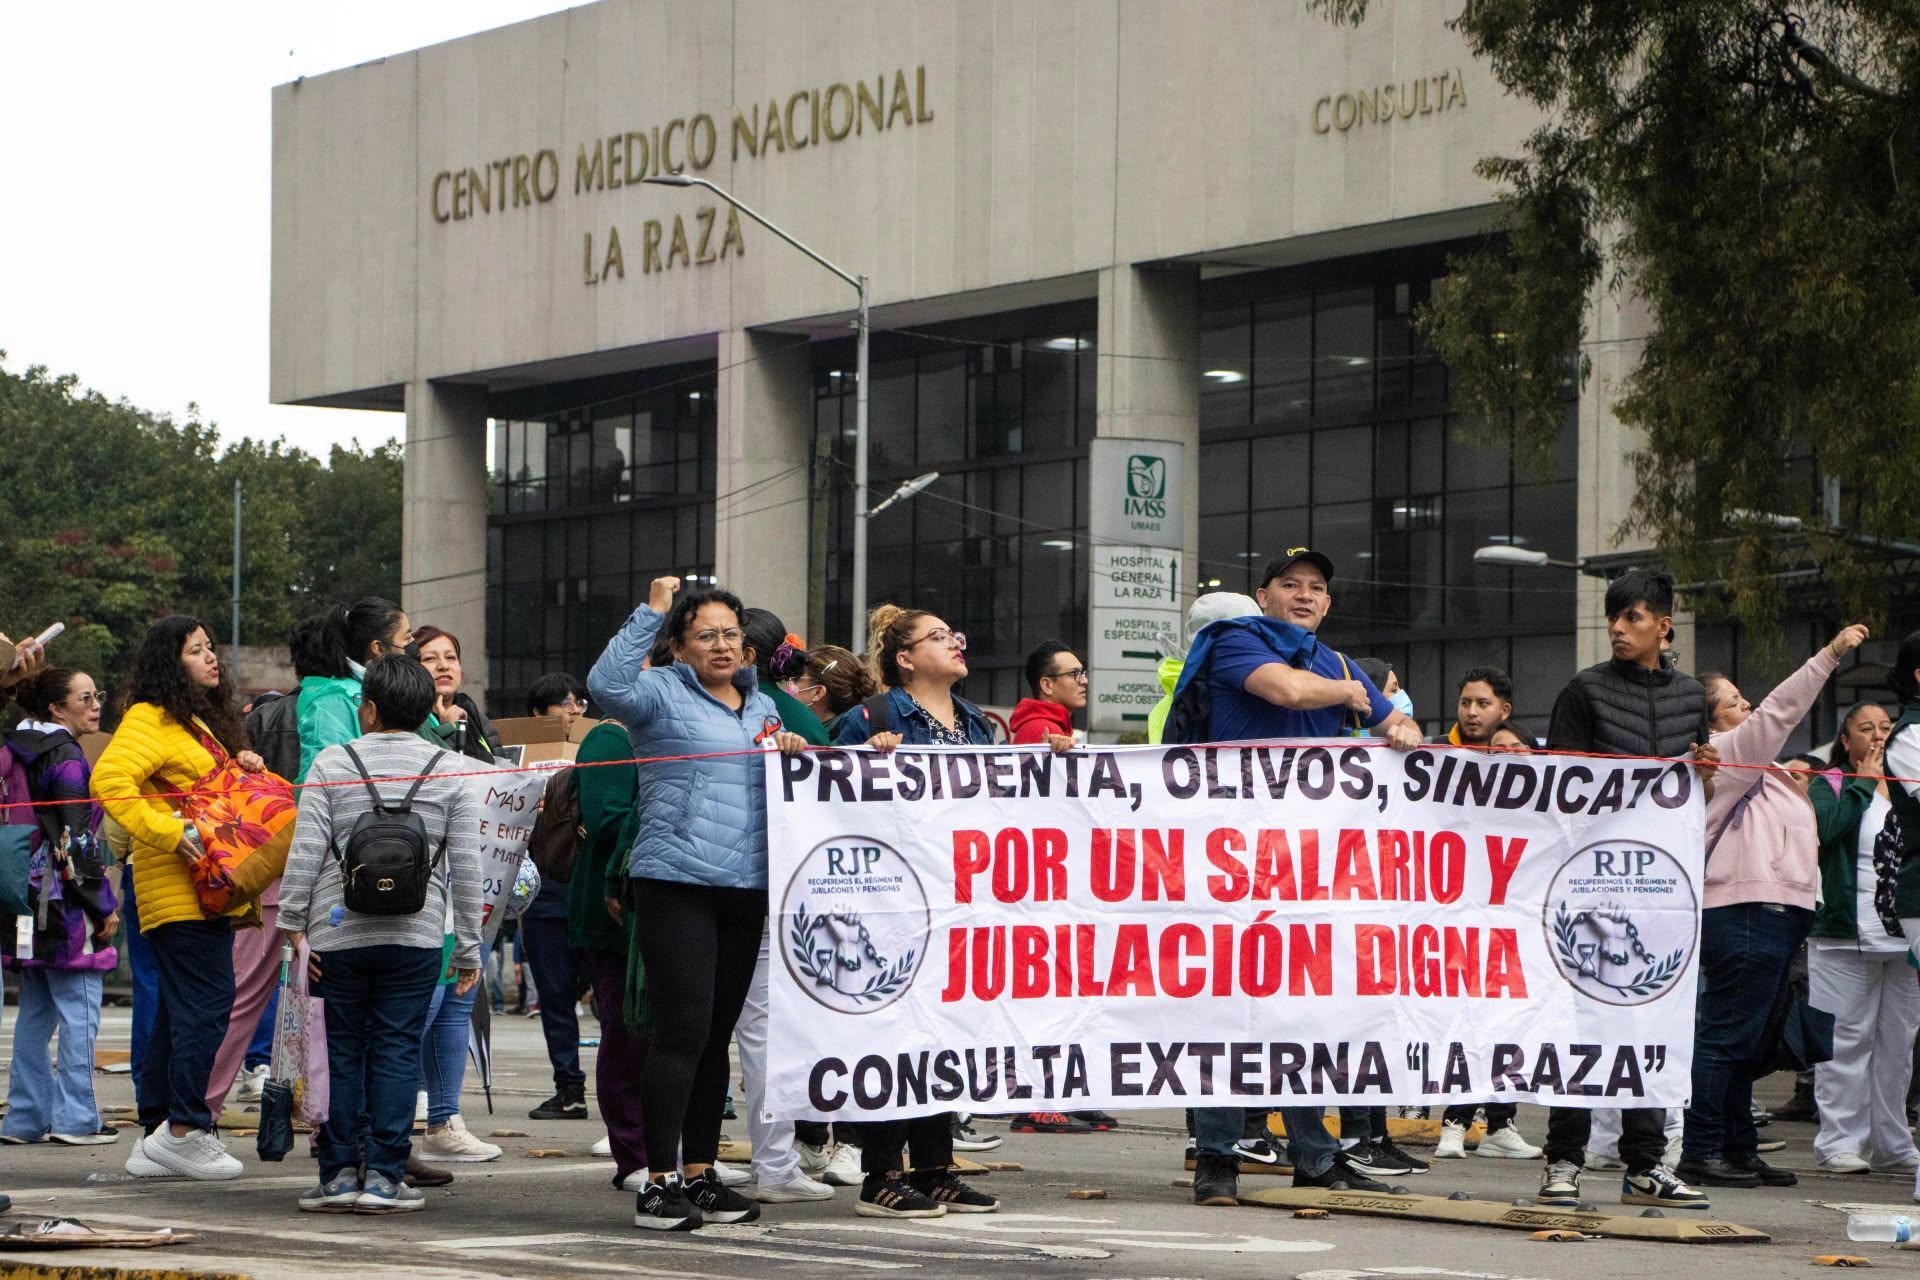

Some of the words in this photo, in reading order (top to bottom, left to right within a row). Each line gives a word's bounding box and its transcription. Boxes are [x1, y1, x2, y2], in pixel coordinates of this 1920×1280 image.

[1312, 68, 1467, 135] CONSULTA
[430, 149, 559, 224] CENTRO
[574, 112, 717, 196] MEDICO
[730, 64, 935, 162] NACIONAL
[583, 225, 625, 285] LA
[642, 201, 745, 275] RAZA
[1124, 498, 1166, 518] IMSS
[1130, 521, 1161, 532] UMAES
[1110, 556, 1165, 569] HOSPITAL
[1110, 571, 1165, 584] GENERAL
[1114, 587, 1130, 597] LA
[1133, 587, 1162, 599] RAZA
[1115, 619, 1160, 631] HOSPITAL
[1161, 621, 1171, 631] DE
[1117, 683, 1158, 693] HOSPITAL
[1098, 694, 1133, 704] GINECO
[780, 751, 1142, 812] PRESIDENTA,
[1162, 746, 1388, 814] OLIVOS,
[1404, 750, 1691, 816] SINDICATO
[485, 786, 525, 813] MÁS
[826, 847, 881, 876] RJP
[952, 828, 1068, 904] POR
[1090, 828, 1186, 903] UN
[1206, 828, 1466, 905] SALARIO
[1485, 835, 1528, 905] Y
[1593, 850, 1655, 876] RJP
[808, 877, 853, 886] RECUPEREMOS
[854, 877, 863, 885] EL
[810, 886, 854, 894] JUBILACIONES
[862, 885, 901, 893] PENSIONES
[1635, 877, 1667, 886] RÉGIMEN
[1571, 886, 1624, 894] JUBILACIONES
[941, 910, 1333, 1003] JUBILACIÓN
[1355, 924, 1529, 999] DIGNA
[808, 1043, 1090, 1113] CONSULTA
[1110, 1042, 1394, 1097] EXTERNA
